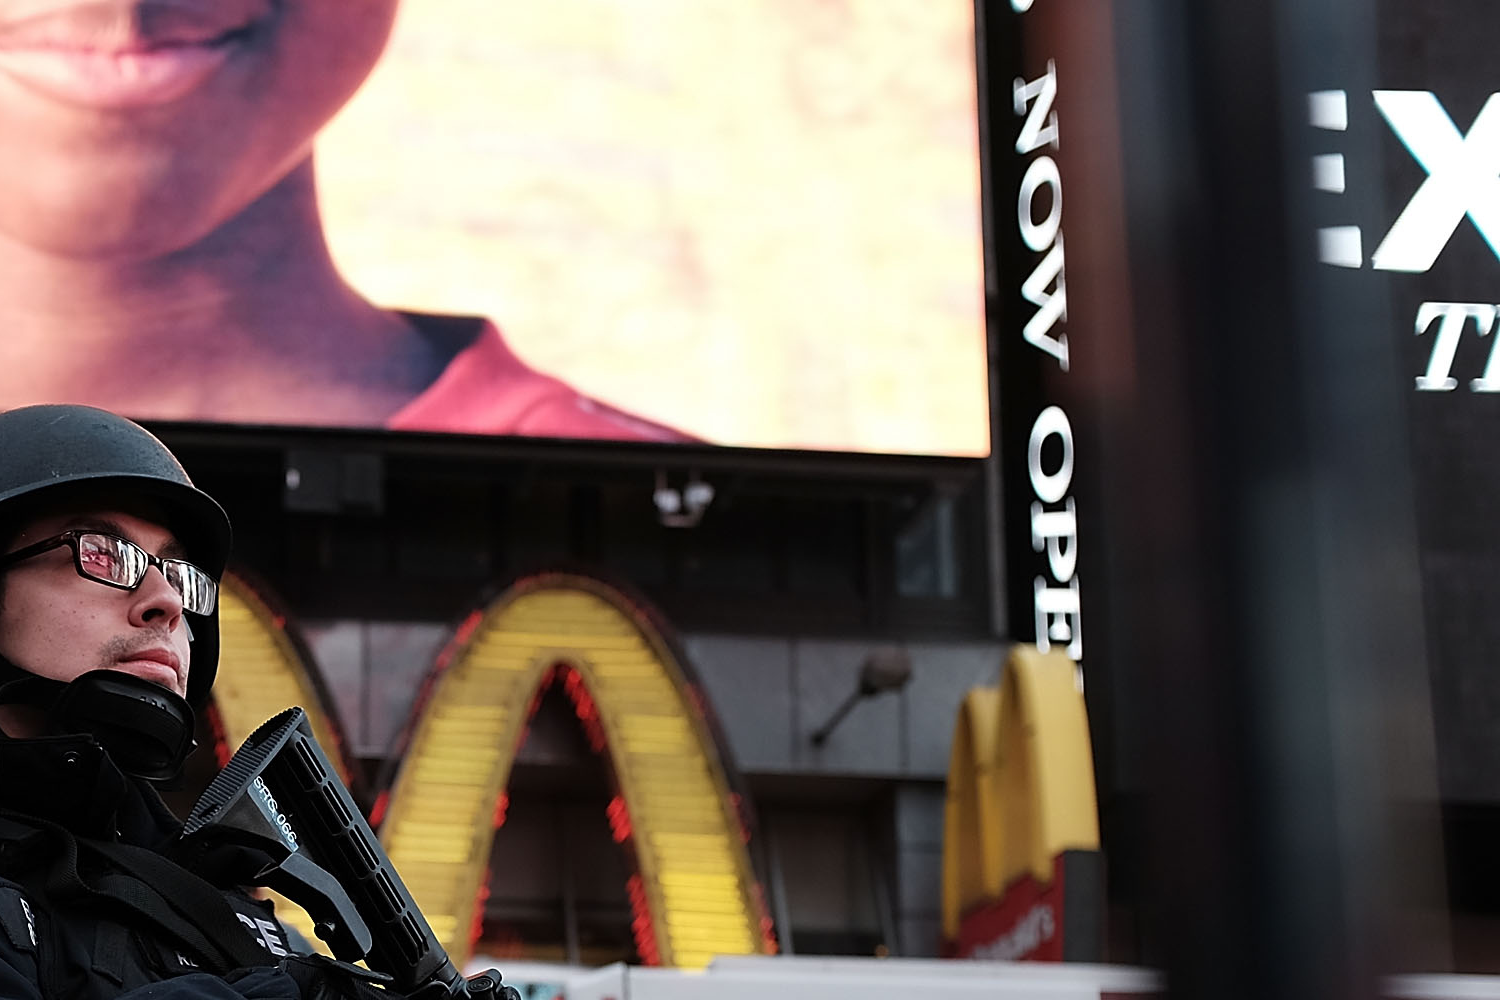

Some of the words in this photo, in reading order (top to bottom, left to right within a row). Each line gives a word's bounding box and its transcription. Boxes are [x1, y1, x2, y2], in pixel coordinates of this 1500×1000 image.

[1012, 57, 1070, 373] NOW
[1027, 404, 1085, 692] OPE
[253, 775, 278, 813] SRG
[276, 813, 298, 844] 066
